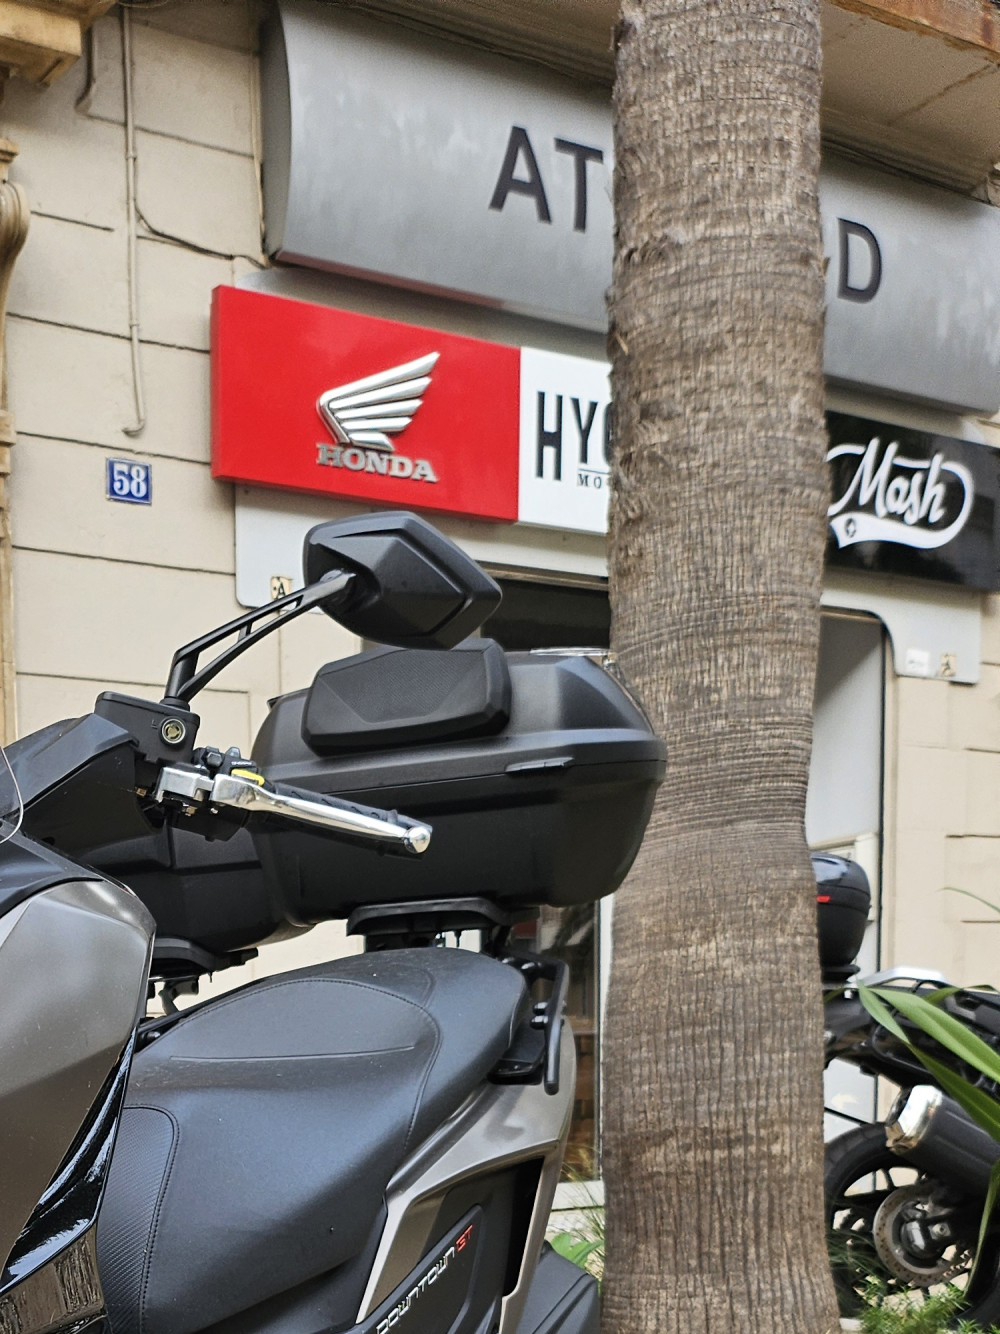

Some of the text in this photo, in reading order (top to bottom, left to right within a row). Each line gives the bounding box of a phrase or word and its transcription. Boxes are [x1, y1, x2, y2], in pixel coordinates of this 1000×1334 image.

[113, 463, 147, 498] 58
[316, 443, 439, 483] HONDA
[827, 436, 946, 525] Mash
[455, 1224, 474, 1253] GT
